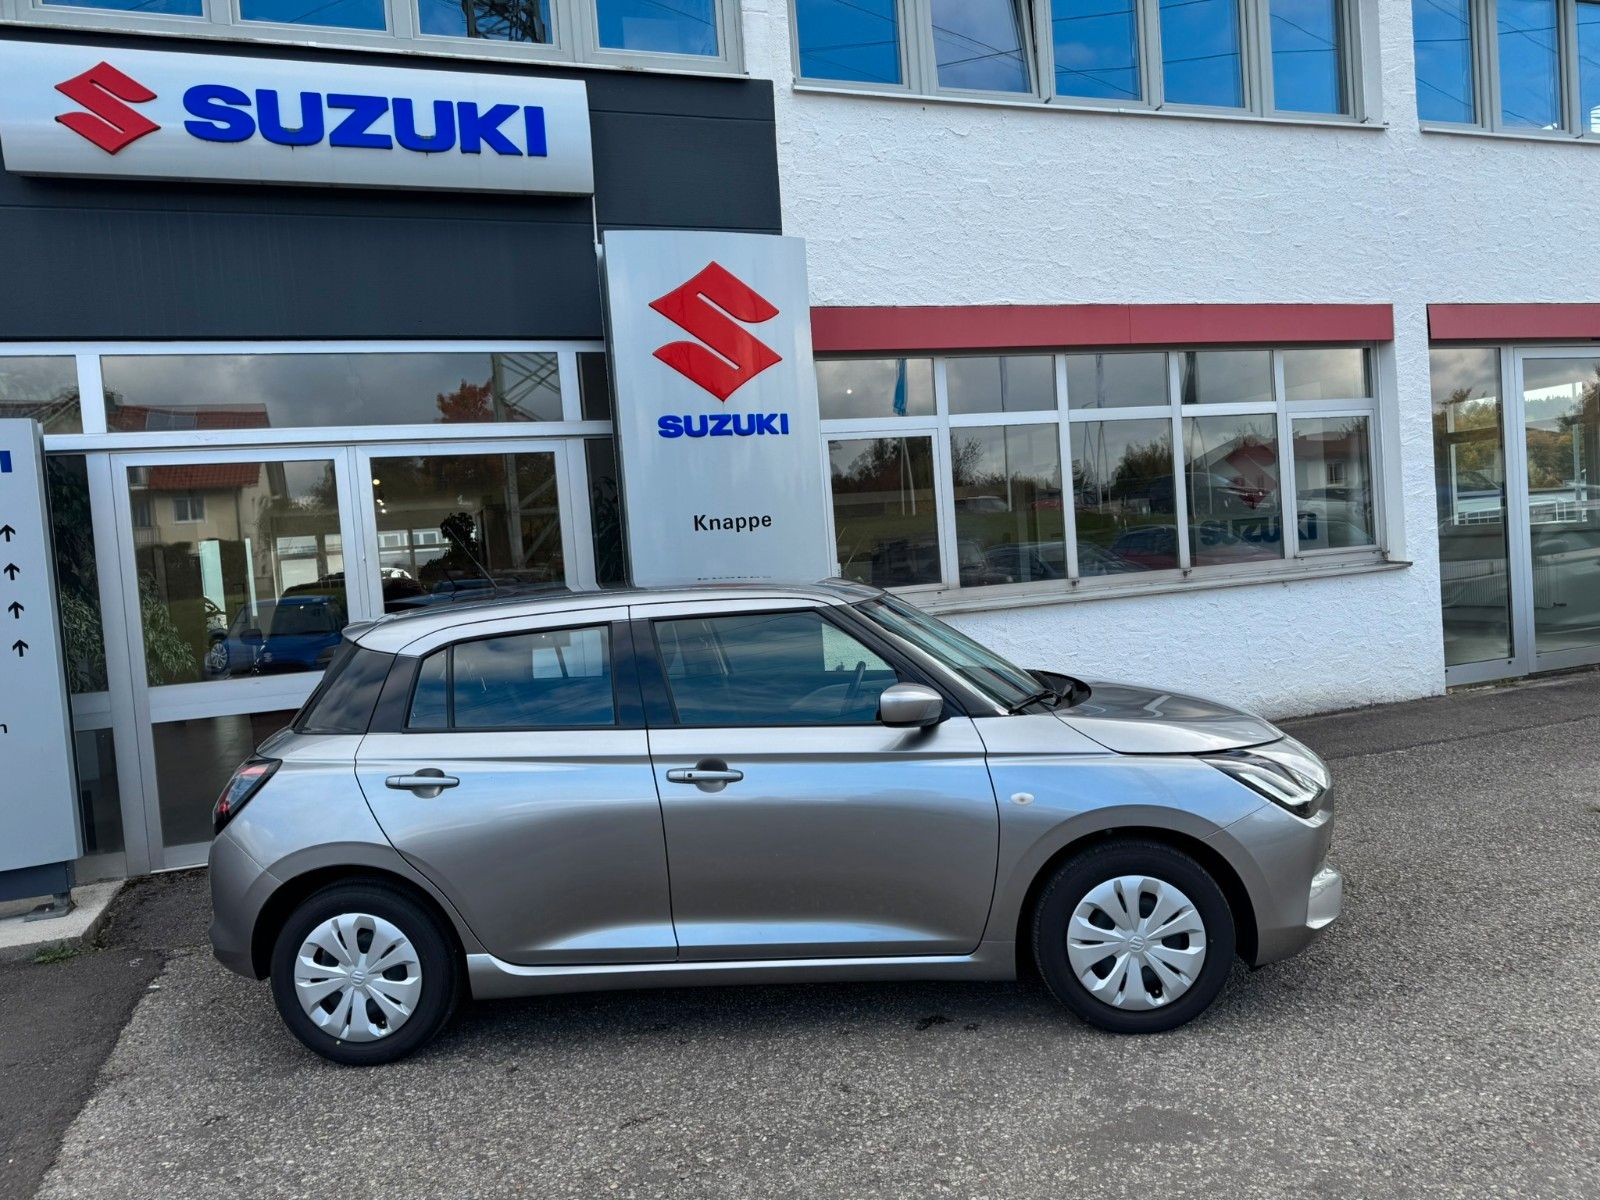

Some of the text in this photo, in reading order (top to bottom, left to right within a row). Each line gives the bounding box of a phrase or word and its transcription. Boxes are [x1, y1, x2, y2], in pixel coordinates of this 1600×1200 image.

[183, 84, 548, 157] SUZUKI
[658, 412, 789, 438] SUZUKI
[693, 513, 773, 533] Knappe
